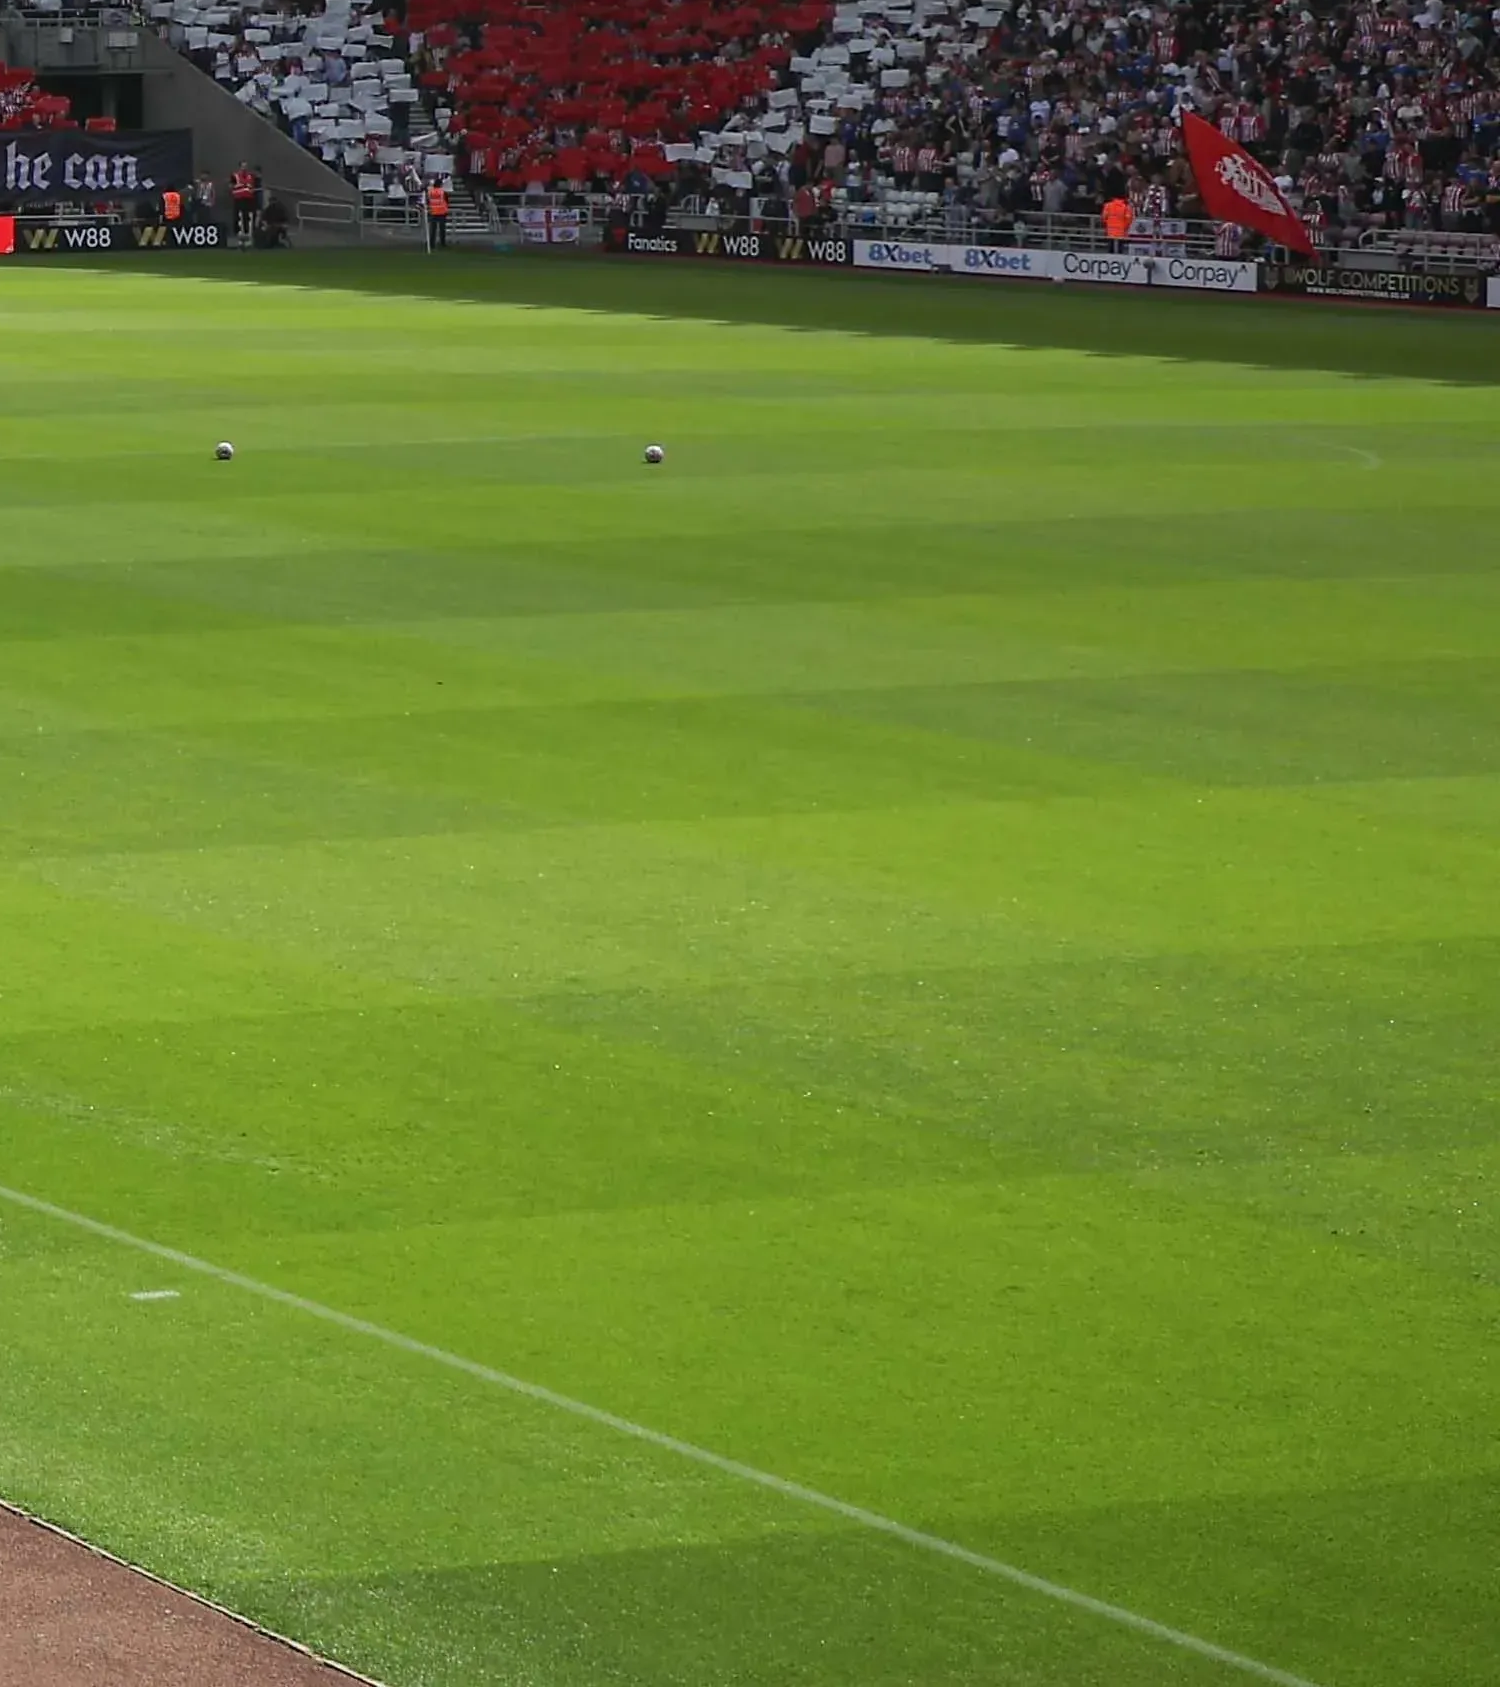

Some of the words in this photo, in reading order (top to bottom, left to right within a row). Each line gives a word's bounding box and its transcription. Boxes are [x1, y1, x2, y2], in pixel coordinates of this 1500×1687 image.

[5, 140, 52, 190] he
[64, 153, 155, 190] can.
[65, 227, 112, 248] W88
[173, 224, 219, 245] W88
[627, 232, 678, 253] Fanatics
[722, 235, 760, 257] W88
[808, 240, 847, 262] W88
[867, 241, 933, 266] 8Xbet
[963, 246, 1032, 272] 8Xbet
[1339, 272, 1460, 296] COMPETITIONS
